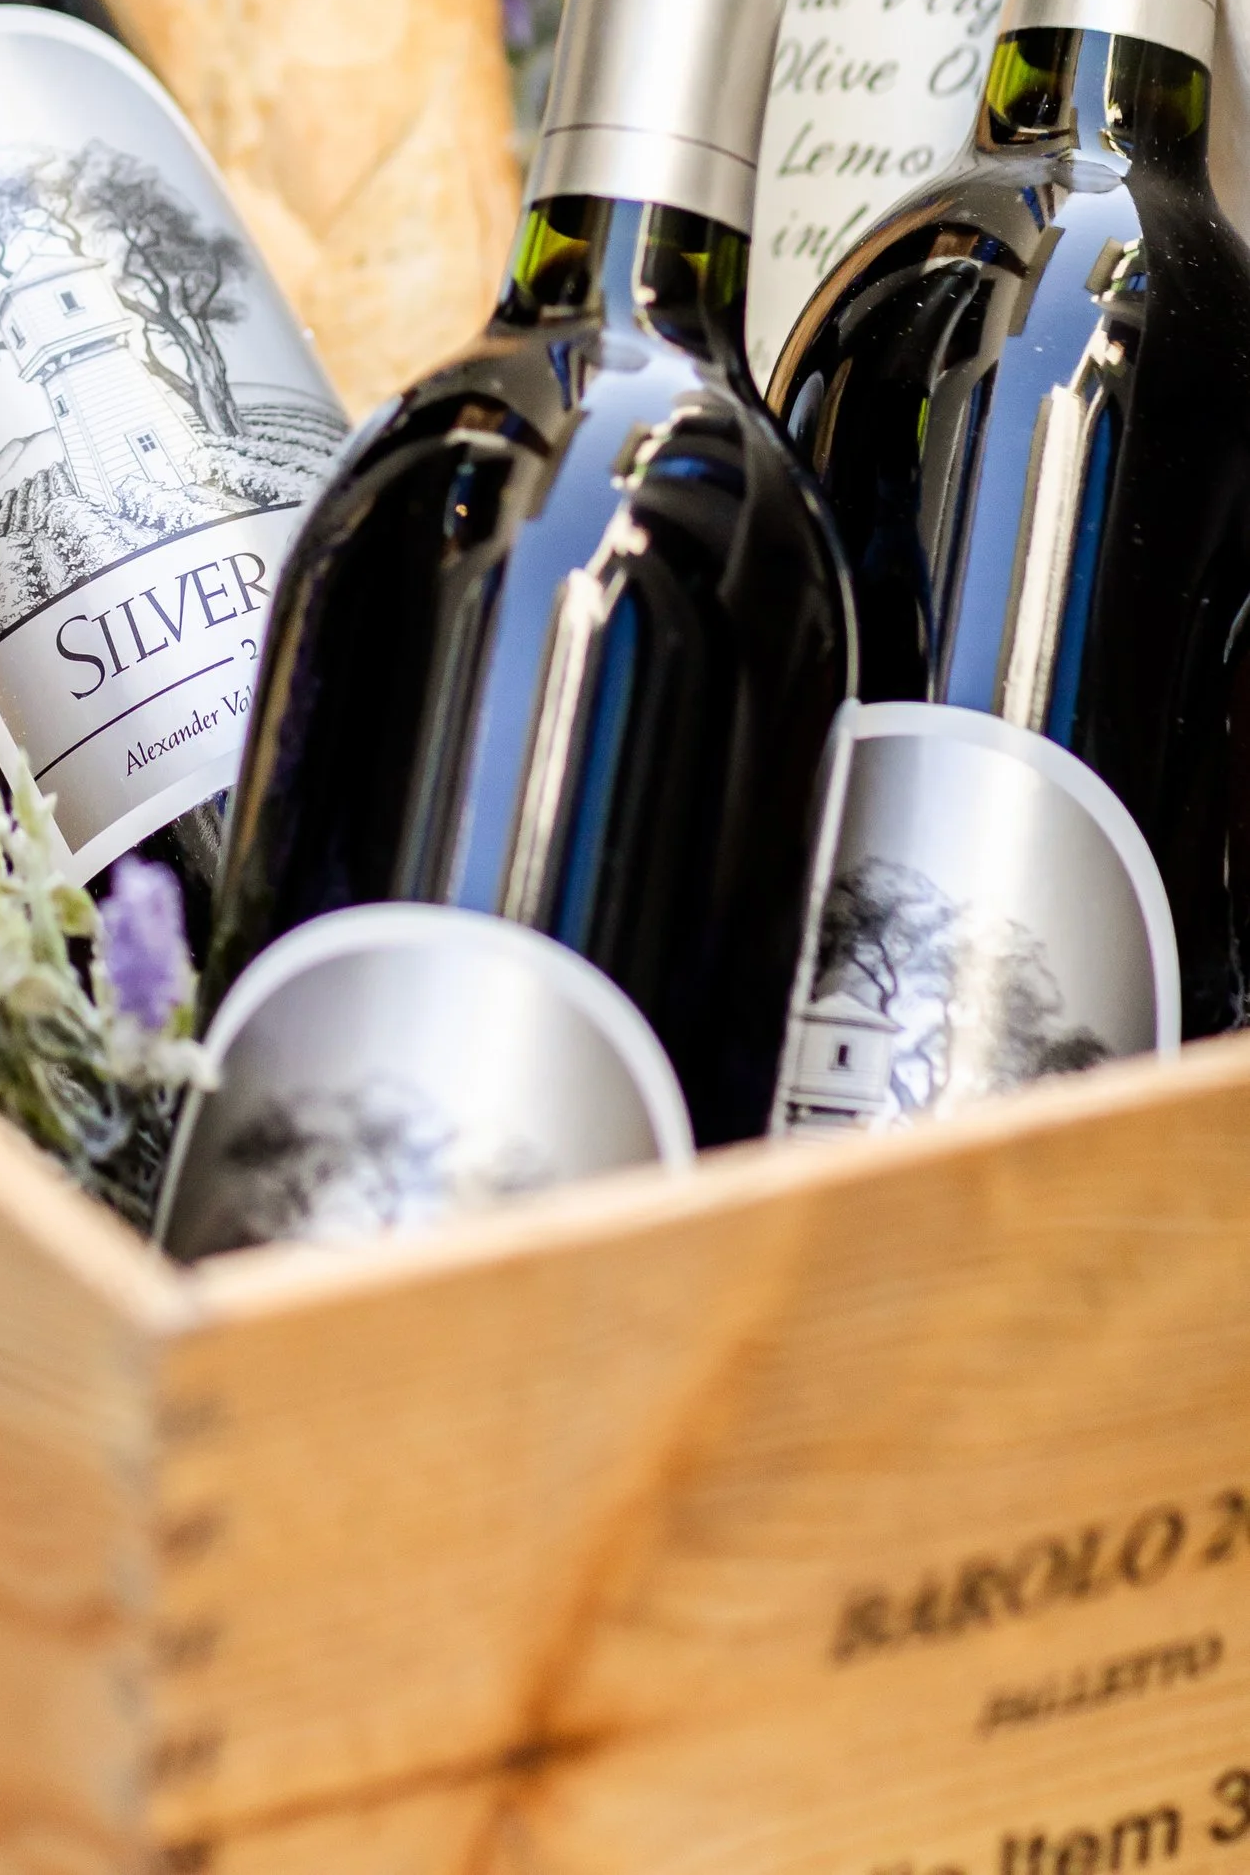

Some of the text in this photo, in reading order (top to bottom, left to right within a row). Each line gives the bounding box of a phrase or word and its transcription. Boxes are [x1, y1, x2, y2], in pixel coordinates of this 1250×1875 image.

[772, 37, 981, 98] Olive O
[777, 120, 937, 180] Lemo
[771, 203, 869, 277] inf
[56, 552, 273, 700] SILVER
[240, 638, 259, 661] 2
[126, 709, 219, 776] Alexander
[1200, 1486, 1250, 1569] 2
